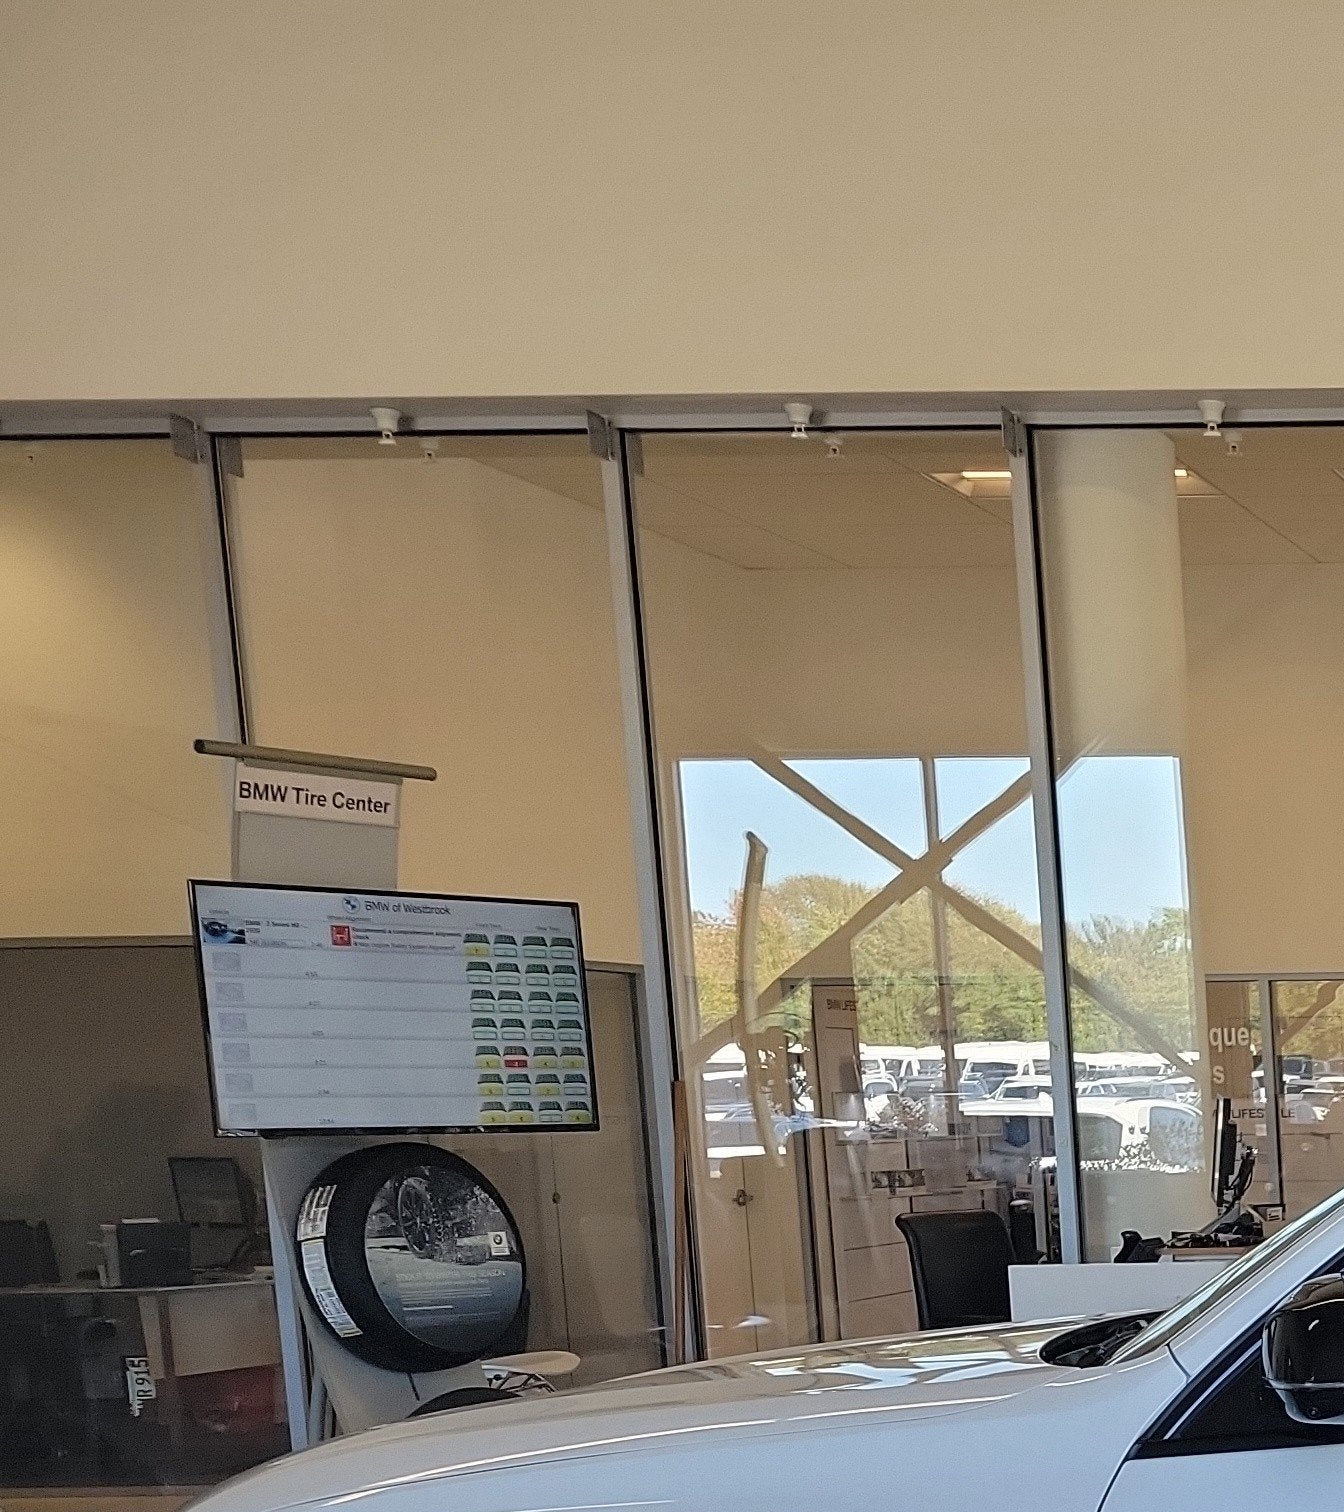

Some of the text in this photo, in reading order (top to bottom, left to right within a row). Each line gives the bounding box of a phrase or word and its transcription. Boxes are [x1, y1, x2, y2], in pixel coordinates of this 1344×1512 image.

[238, 780, 391, 814] BMW Tire Center
[364, 900, 390, 912] BMW
